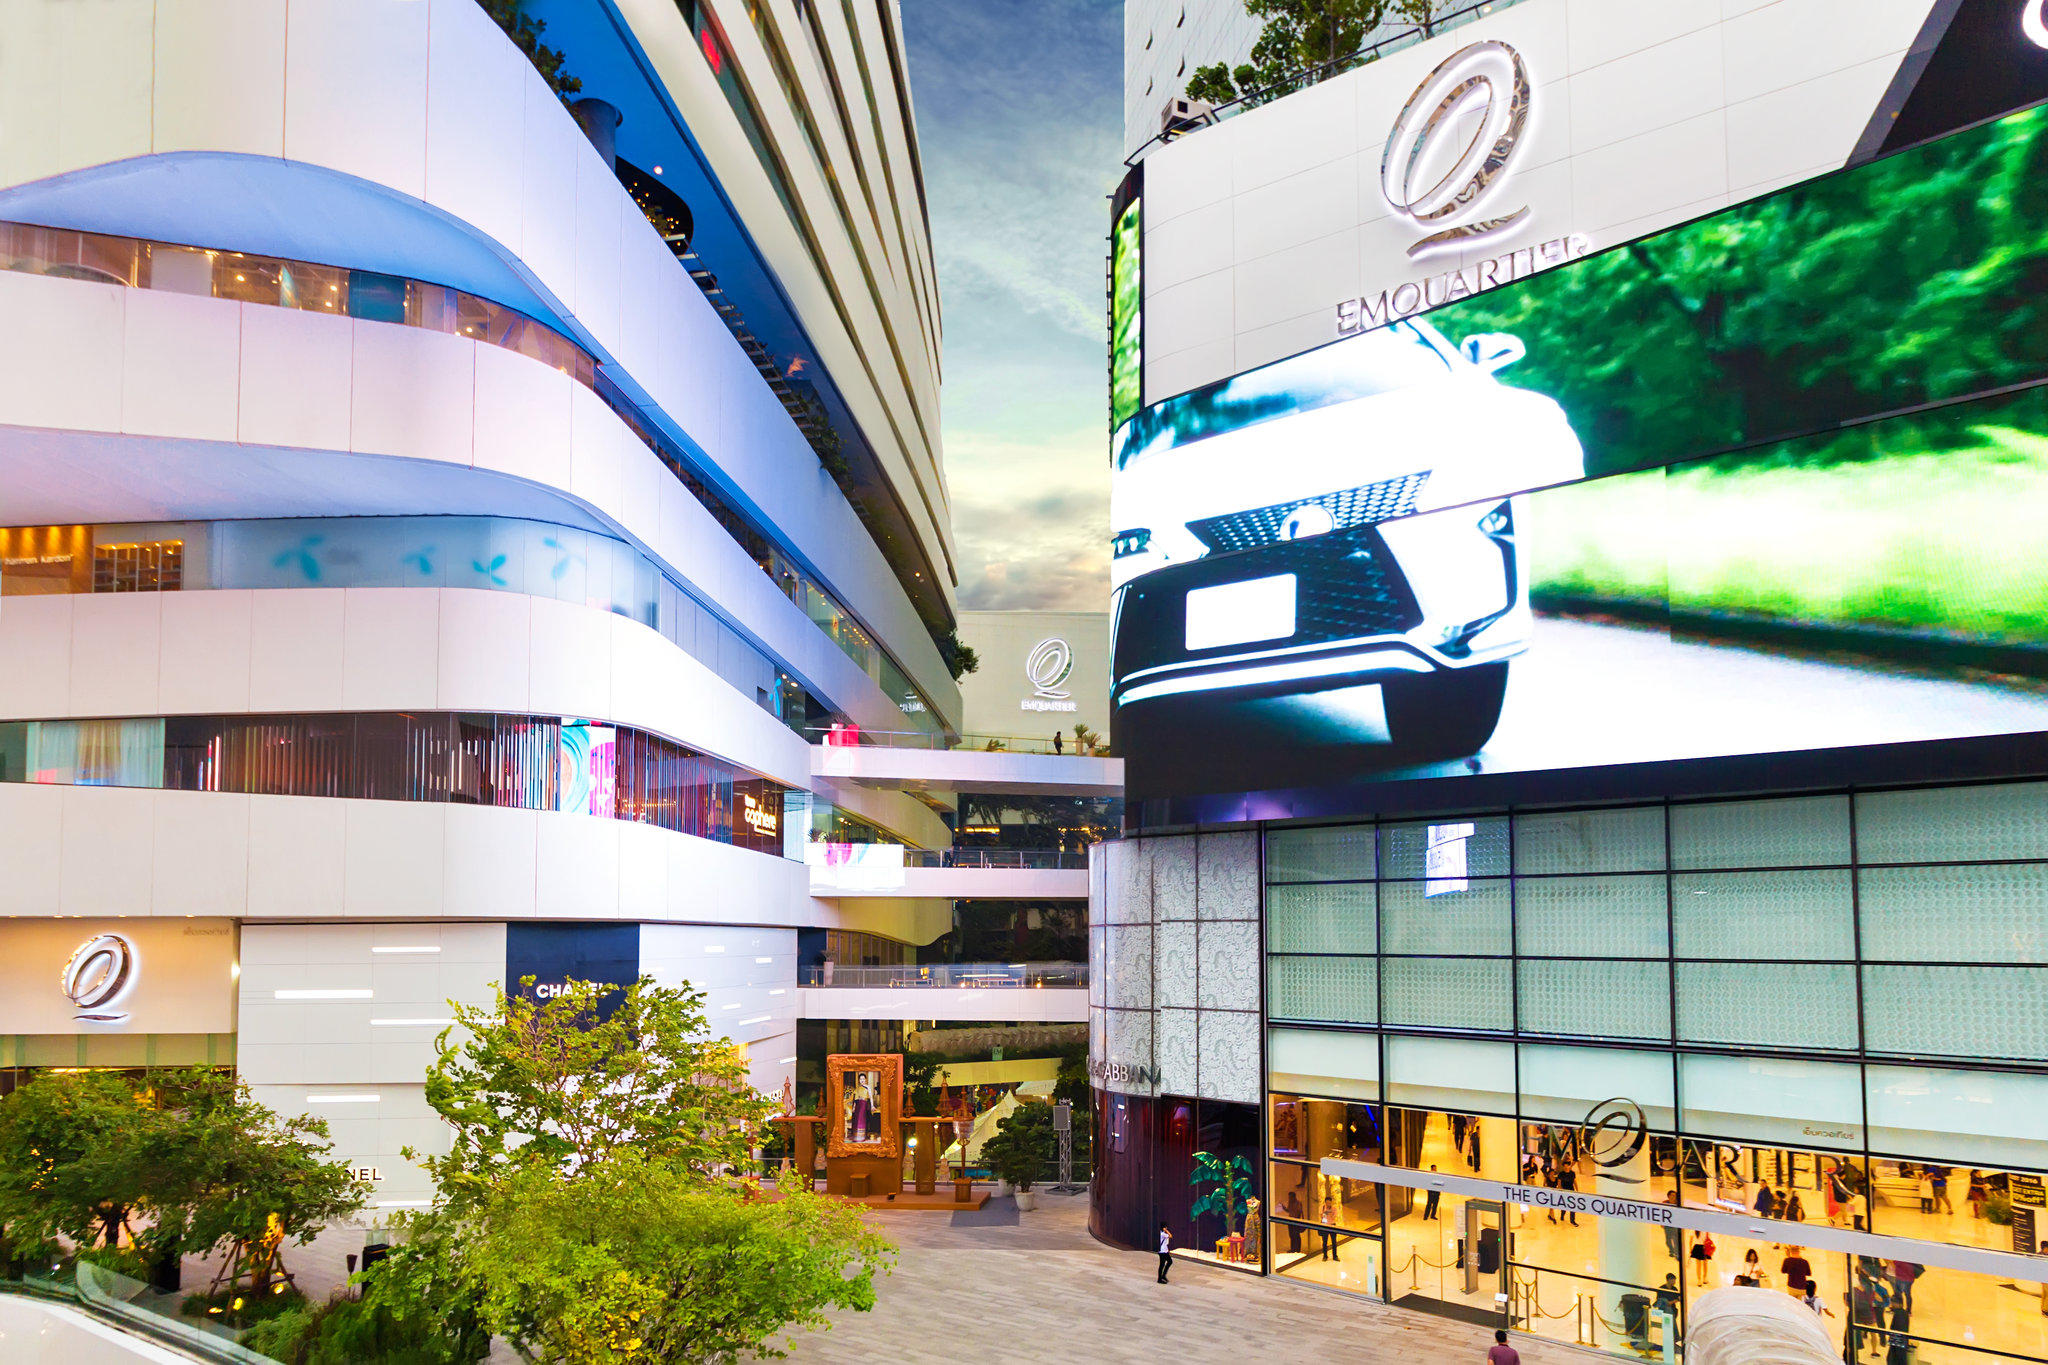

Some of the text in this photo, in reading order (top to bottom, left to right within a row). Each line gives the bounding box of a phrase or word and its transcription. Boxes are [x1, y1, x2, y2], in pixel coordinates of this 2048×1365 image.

[536, 982, 608, 999] CHAEL
[1503, 1186, 1673, 1224] THE GLASS QUARTIER
